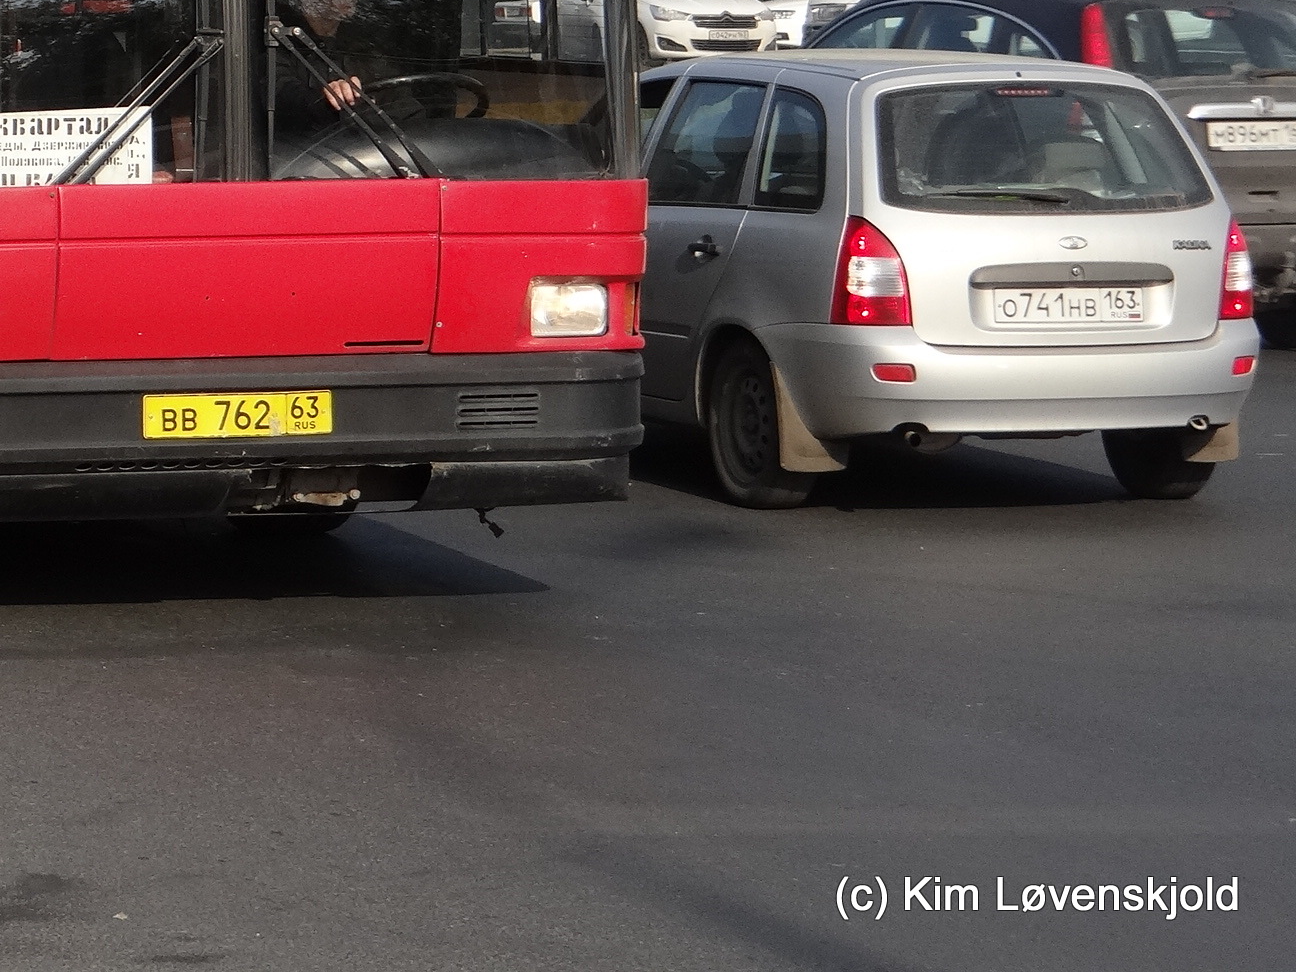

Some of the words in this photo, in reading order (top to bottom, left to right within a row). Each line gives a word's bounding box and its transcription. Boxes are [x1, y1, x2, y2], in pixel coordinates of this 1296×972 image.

[1002, 292, 1098, 319] О741НВ
[1104, 290, 1136, 309] 163
[1110, 311, 1128, 319] RUS
[161, 408, 198, 432] ВВ
[213, 400, 271, 431] 762
[290, 396, 319, 419] 63
[294, 421, 316, 430] RUS
